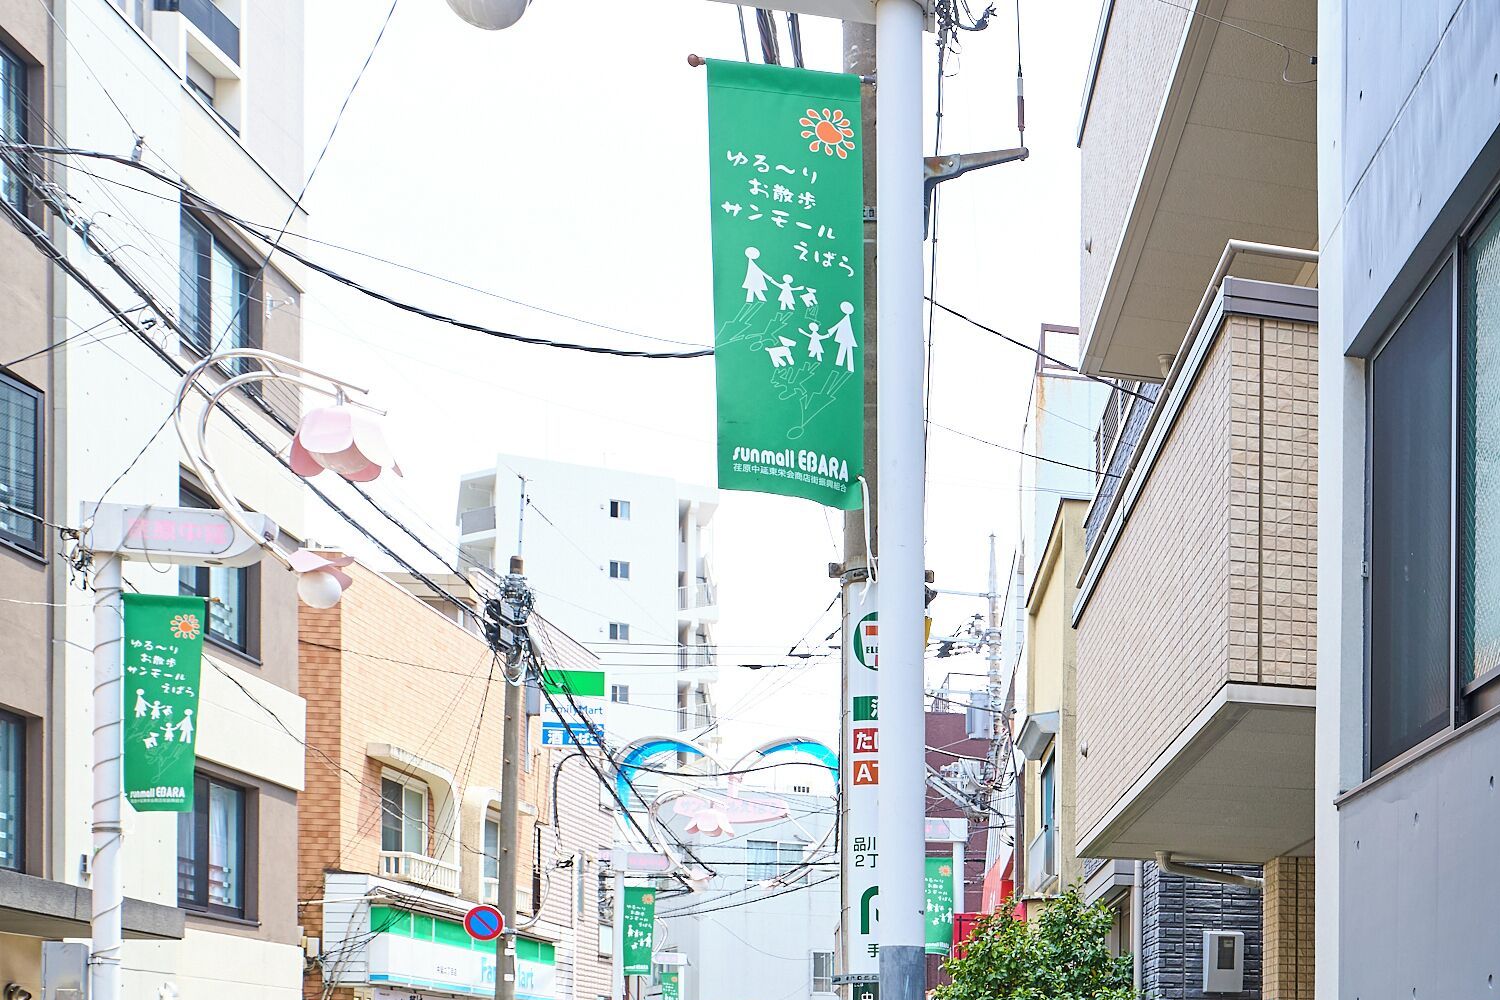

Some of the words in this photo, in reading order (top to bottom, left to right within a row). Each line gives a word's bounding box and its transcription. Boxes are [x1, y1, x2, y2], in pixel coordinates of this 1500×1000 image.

[748, 178, 817, 210] お散歩
[721, 201, 836, 240] サンモール
[793, 241, 855, 278] えばら
[732, 446, 795, 469] sunmall
[798, 449, 849, 483] EBARA
[140, 652, 177, 668] お散歩
[127, 665, 186, 681] サンモール
[160, 682, 195, 698] えばら
[544, 703, 604, 716] FamilyMart
[547, 730, 564, 745] 酒
[855, 731, 879, 750] た
